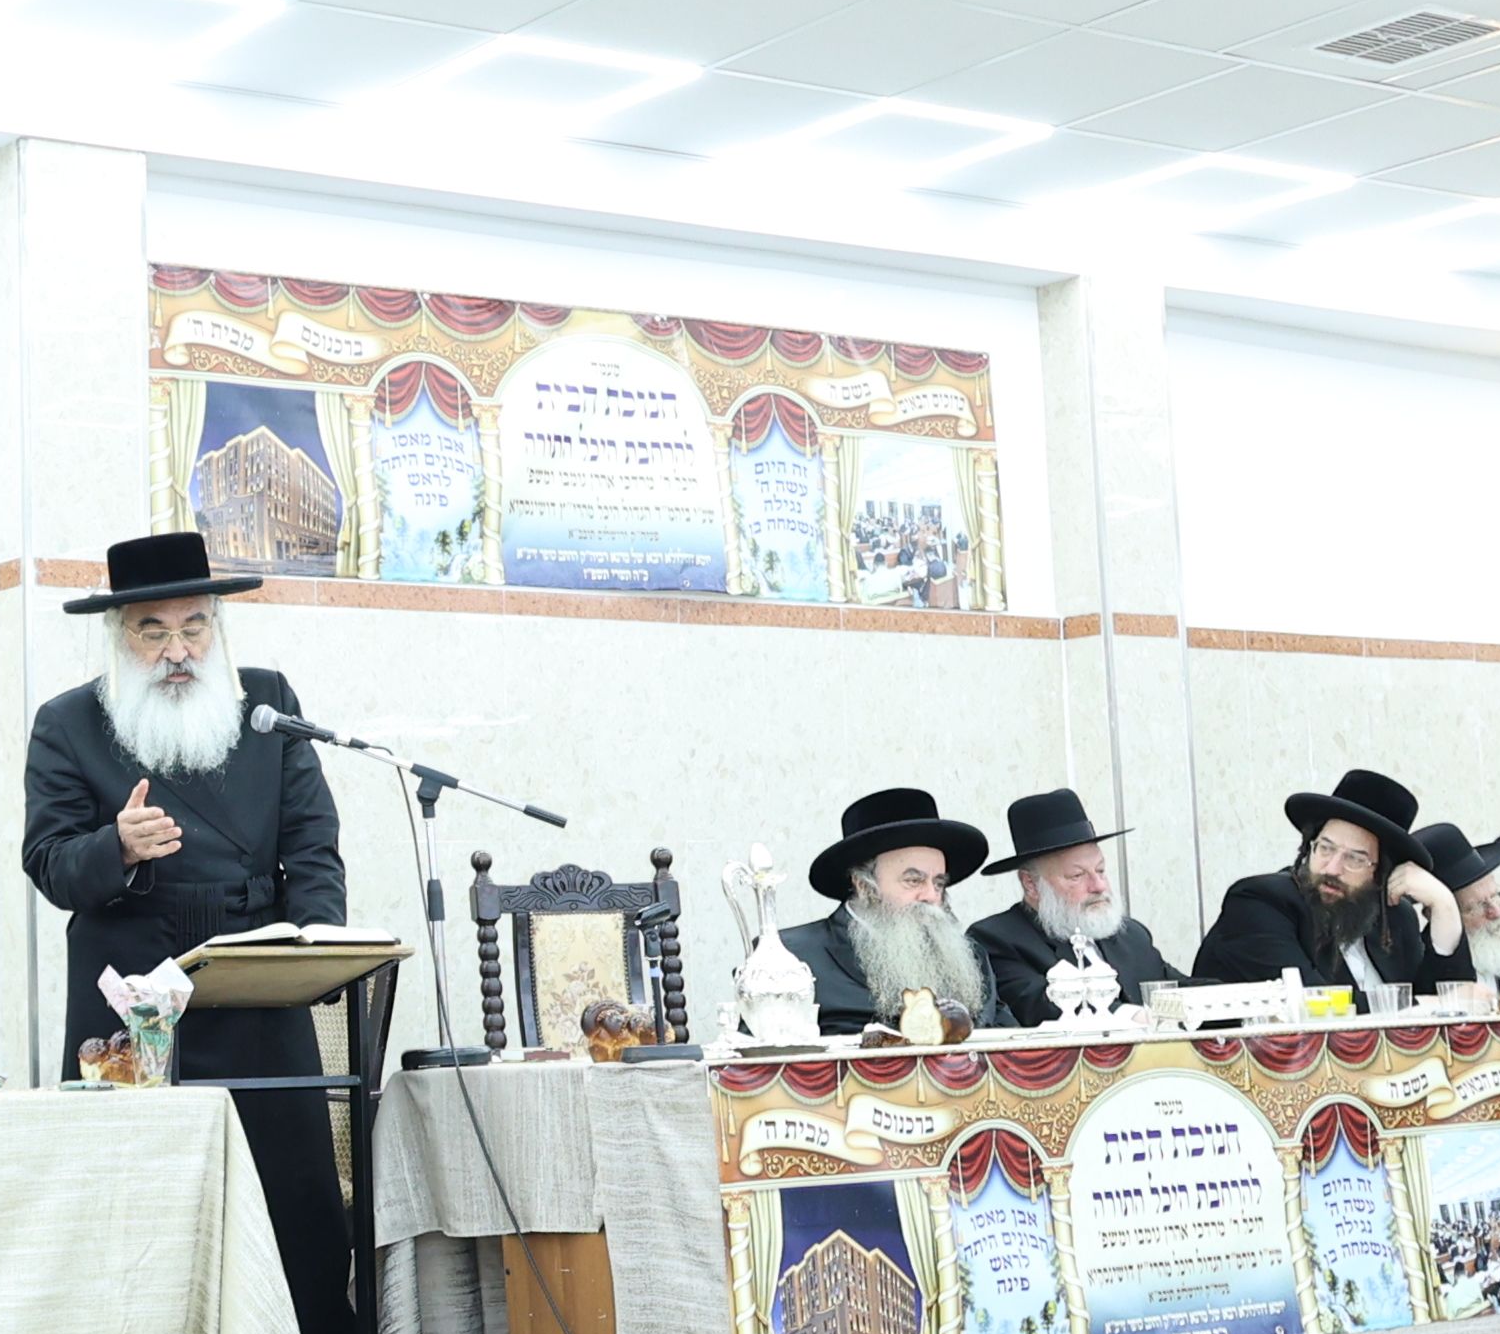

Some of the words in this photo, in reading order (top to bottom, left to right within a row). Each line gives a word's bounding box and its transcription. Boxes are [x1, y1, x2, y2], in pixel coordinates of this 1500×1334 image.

[187, 317, 204, 337] ה'
[210, 320, 254, 351] מבית
[301, 325, 363, 357] ברכנוכם
[535, 381, 598, 416] הבית
[841, 382, 872, 401] בשם
[931, 393, 966, 411] ברוכים
[605, 387, 678, 419] חנוכת
[898, 393, 931, 414] הבאים
[392, 433, 432, 448] מאסו
[437, 435, 465, 454] אבן
[524, 432, 572, 459] התורה
[579, 422, 617, 462] היכל
[624, 429, 695, 466] להרחבת
[381, 453, 418, 474] היתה
[424, 453, 476, 478] הבונים
[754, 460, 787, 475] היום
[792, 462, 808, 478] זה
[407, 469, 452, 487] לראש
[619, 475, 655, 491] מרדכי
[755, 478, 770, 493] ה'
[775, 480, 808, 497] עשה
[414, 493, 449, 507] פינה
[764, 493, 802, 514] נגילה
[749, 521, 762, 539] בו
[766, 518, 819, 539] ונשמחה
[1386, 1080, 1399, 1099] ה'
[1402, 1073, 1430, 1098] בשם
[1456, 1073, 1491, 1100] הבאים
[758, 1119, 777, 1140] ה'
[872, 1107, 935, 1135] ברכנוכם
[785, 1119, 830, 1147] מבית
[1171, 1122, 1241, 1159] חנוכת
[1103, 1128, 1164, 1165] הבית
[1147, 1171, 1190, 1214] היכל
[1195, 1162, 1263, 1210] להרחבת
[1322, 1177, 1353, 1198] היום
[1356, 1177, 1373, 1193] זה
[1092, 1187, 1145, 1219] התורה
[1325, 1201, 1340, 1217] ה'
[1343, 1198, 1376, 1215] עשה
[970, 1208, 1006, 1231] מאסו
[1011, 1209, 1038, 1228] אבן
[1241, 1208, 1264, 1235] היכל
[1335, 1215, 1373, 1238] נגילה
[1164, 1223, 1189, 1246] אהרן
[1192, 1221, 1225, 1239] מרדכי
[963, 1234, 998, 1262] היתה
[1001, 1231, 1050, 1255] הבונים
[1341, 1241, 1395, 1263] ונשמחה
[989, 1248, 1030, 1272] לראש
[1323, 1249, 1338, 1266] בו
[997, 1276, 1030, 1295] פינה
